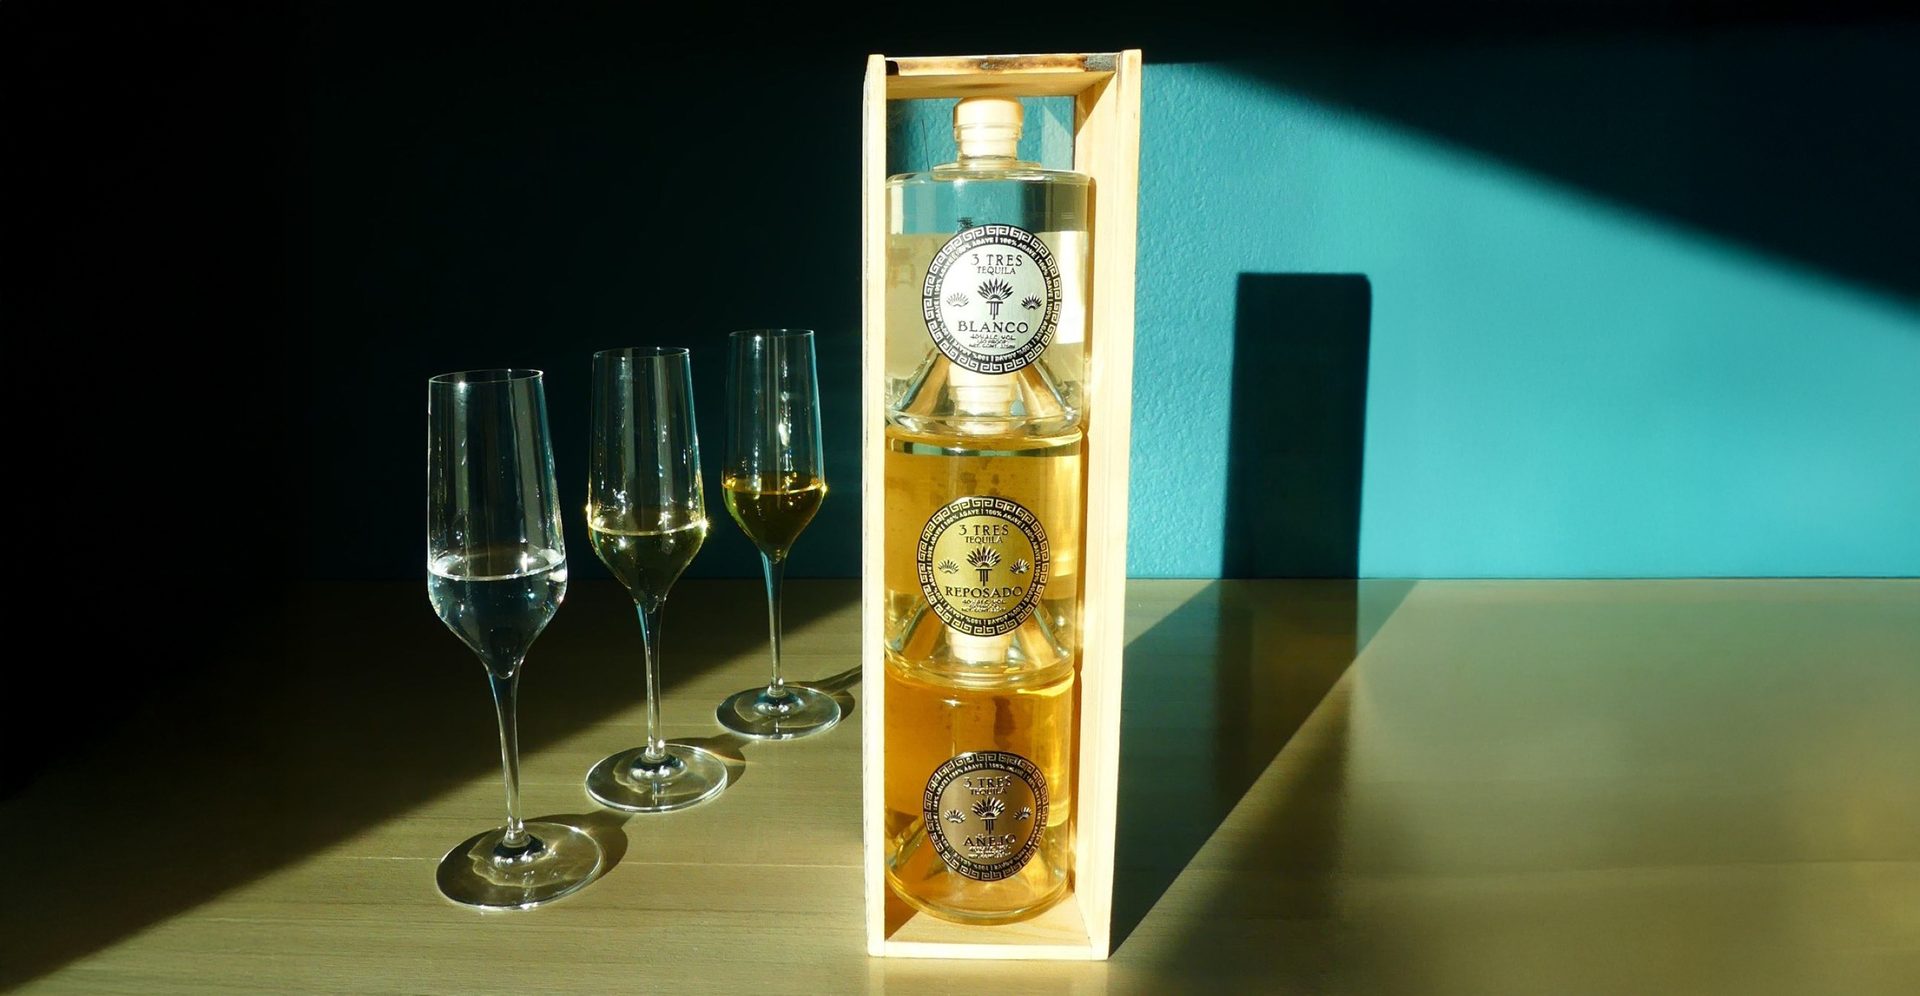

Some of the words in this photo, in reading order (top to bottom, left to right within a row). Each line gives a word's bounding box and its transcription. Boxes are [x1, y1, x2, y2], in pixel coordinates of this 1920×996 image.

[1018, 241, 1036, 257] AGAVE
[971, 254, 980, 266] 3
[987, 254, 1023, 266] TRES
[977, 266, 1016, 275] TEQUILA
[1037, 259, 1047, 275] 100%
[1044, 276, 1052, 297] AGAVE
[1044, 303, 1052, 320] 100%
[958, 321, 1028, 333] BLANCO
[1034, 321, 1048, 340] AGAVE
[959, 524, 967, 536] 3
[975, 525, 1009, 536] TRES
[965, 536, 1003, 544] TEQUILA
[945, 586, 1023, 598] REPOSADO
[963, 776, 971, 788] 3
[977, 775, 1012, 788] TRES
[969, 787, 1007, 795] TEQUILA
[963, 833, 1017, 847] AÑEJO
